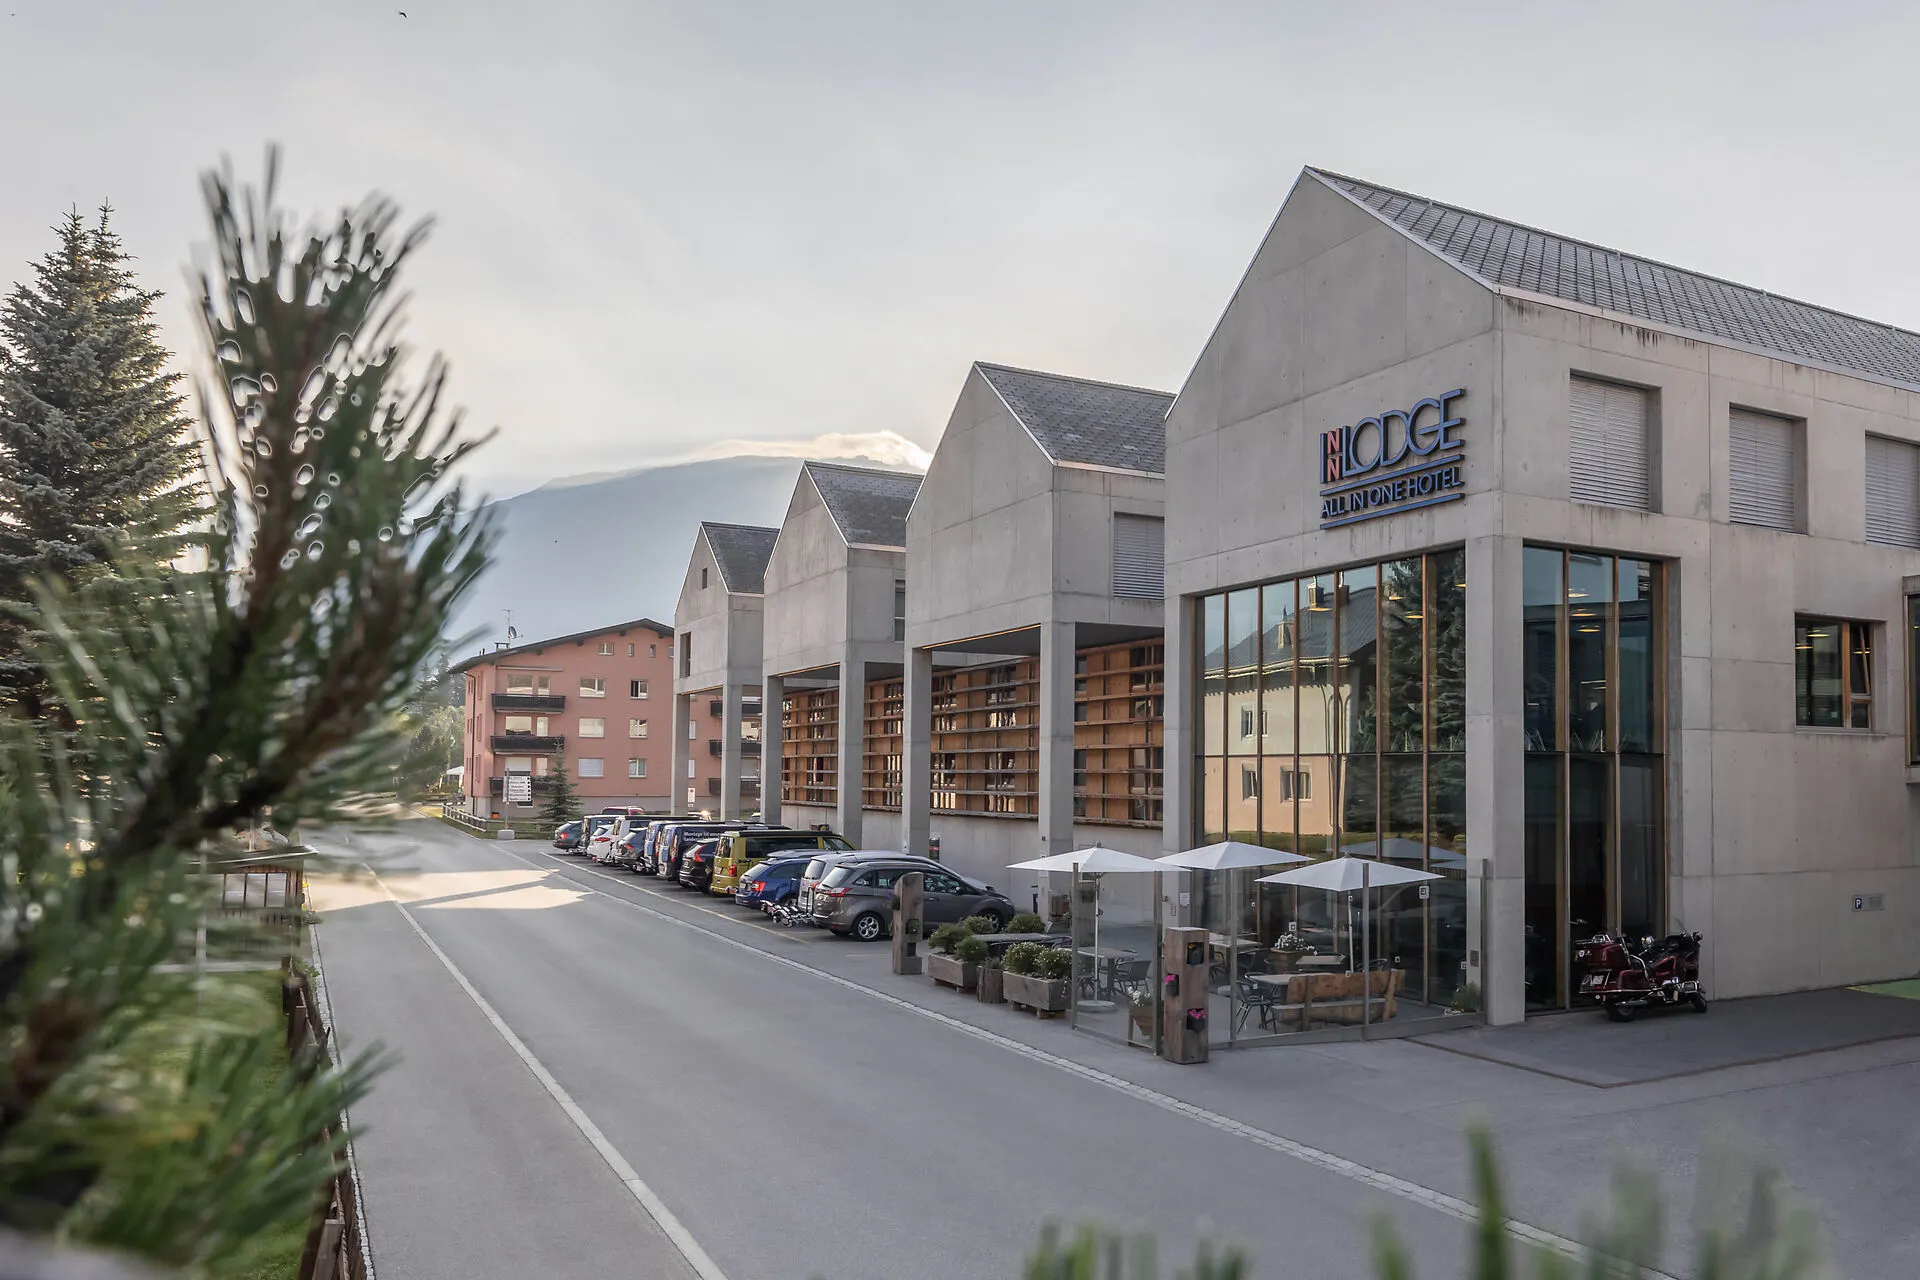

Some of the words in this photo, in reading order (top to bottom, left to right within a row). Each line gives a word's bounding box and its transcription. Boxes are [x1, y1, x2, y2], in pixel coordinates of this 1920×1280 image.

[1342, 388, 1466, 478] LODGE
[1321, 496, 1346, 519] ALL
[1346, 490, 1367, 512] IN
[1368, 481, 1404, 507] ONE
[1407, 467, 1466, 498] HOTEL
